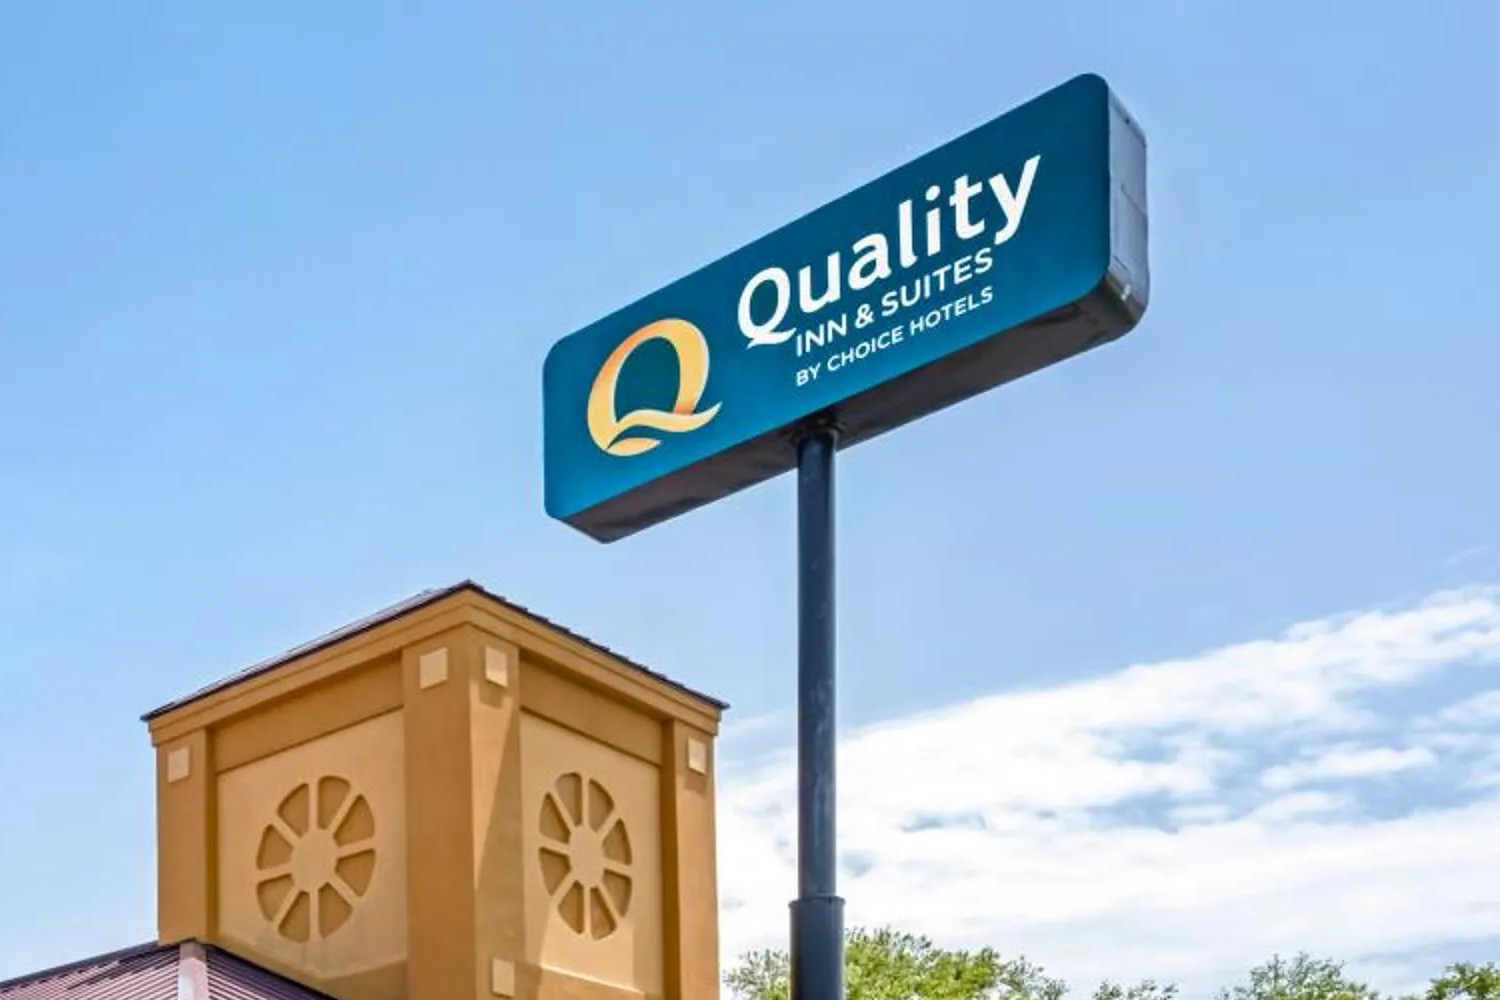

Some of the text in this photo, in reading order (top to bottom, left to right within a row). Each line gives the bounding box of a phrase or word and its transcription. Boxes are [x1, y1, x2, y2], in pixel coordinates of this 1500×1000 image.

[736, 155, 1041, 350] Quality
[796, 247, 993, 357] INN & SUITES
[587, 318, 722, 457] Q
[796, 286, 993, 387] BY CHOICE HOTELS
